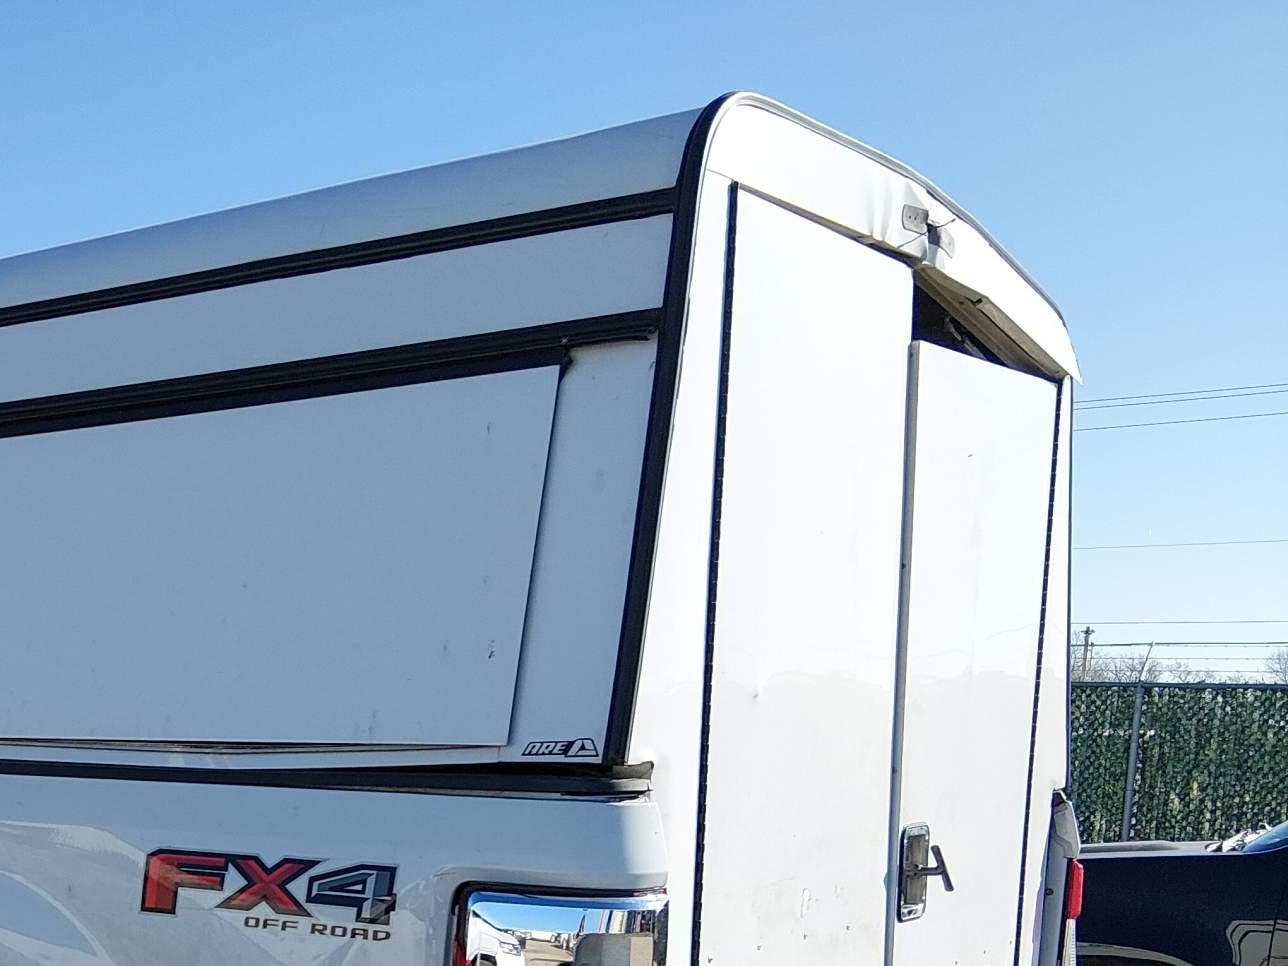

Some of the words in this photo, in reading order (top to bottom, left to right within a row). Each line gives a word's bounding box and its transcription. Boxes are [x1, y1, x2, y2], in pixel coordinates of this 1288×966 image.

[140, 848, 399, 926] FX4
[244, 916, 299, 932] OFF
[310, 923, 392, 941] ROAD
